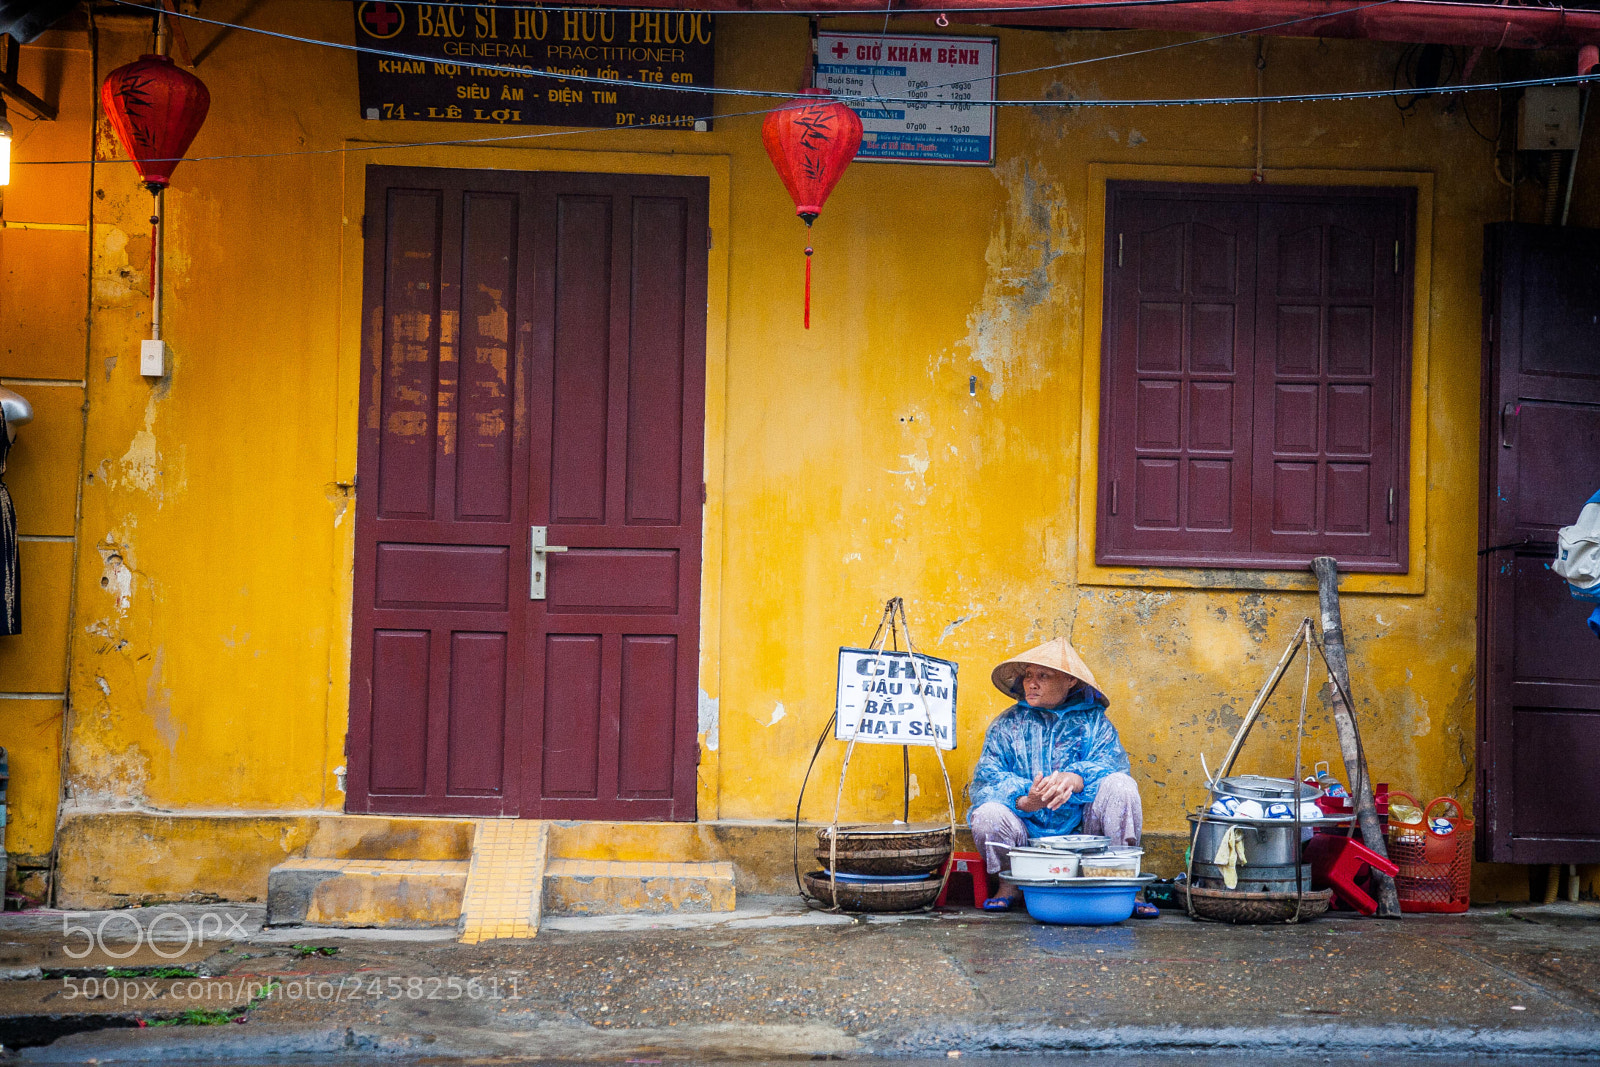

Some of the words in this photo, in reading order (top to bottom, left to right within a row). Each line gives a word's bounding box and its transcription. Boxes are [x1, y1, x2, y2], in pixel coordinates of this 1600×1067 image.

[443, 41, 533, 58] GENERAL
[547, 44, 685, 63] PRACTITIONER
[856, 42, 882, 61] GIỜ
[887, 43, 932, 63] KHÁM
[937, 45, 980, 68] BỆNH
[378, 58, 426, 75] KHÁM
[639, 66, 664, 83] Trẻ
[670, 71, 693, 84] em
[845, 66, 858, 74] hai
[845, 77, 864, 86] Sáng
[907, 81, 928, 89] 07g00
[456, 83, 490, 100] SIÊU
[500, 84, 524, 101] ÂM
[548, 87, 583, 106] ĐIỆN
[591, 90, 617, 104] TIM
[845, 88, 862, 96] Trưa
[908, 91, 928, 99] 10g00
[951, 92, 971, 100] 12g30
[382, 103, 406, 120] 74
[427, 104, 463, 119] LÊ
[473, 108, 522, 124] LỢI
[615, 112, 636, 126] ĐT
[650, 113, 695, 127] 861419
[906, 122, 927, 131] 07g00
[950, 125, 970, 134] 12g30
[856, 658, 942, 682] CHÈ
[865, 697, 915, 716] BẮP
[859, 718, 901, 739] HẠT
